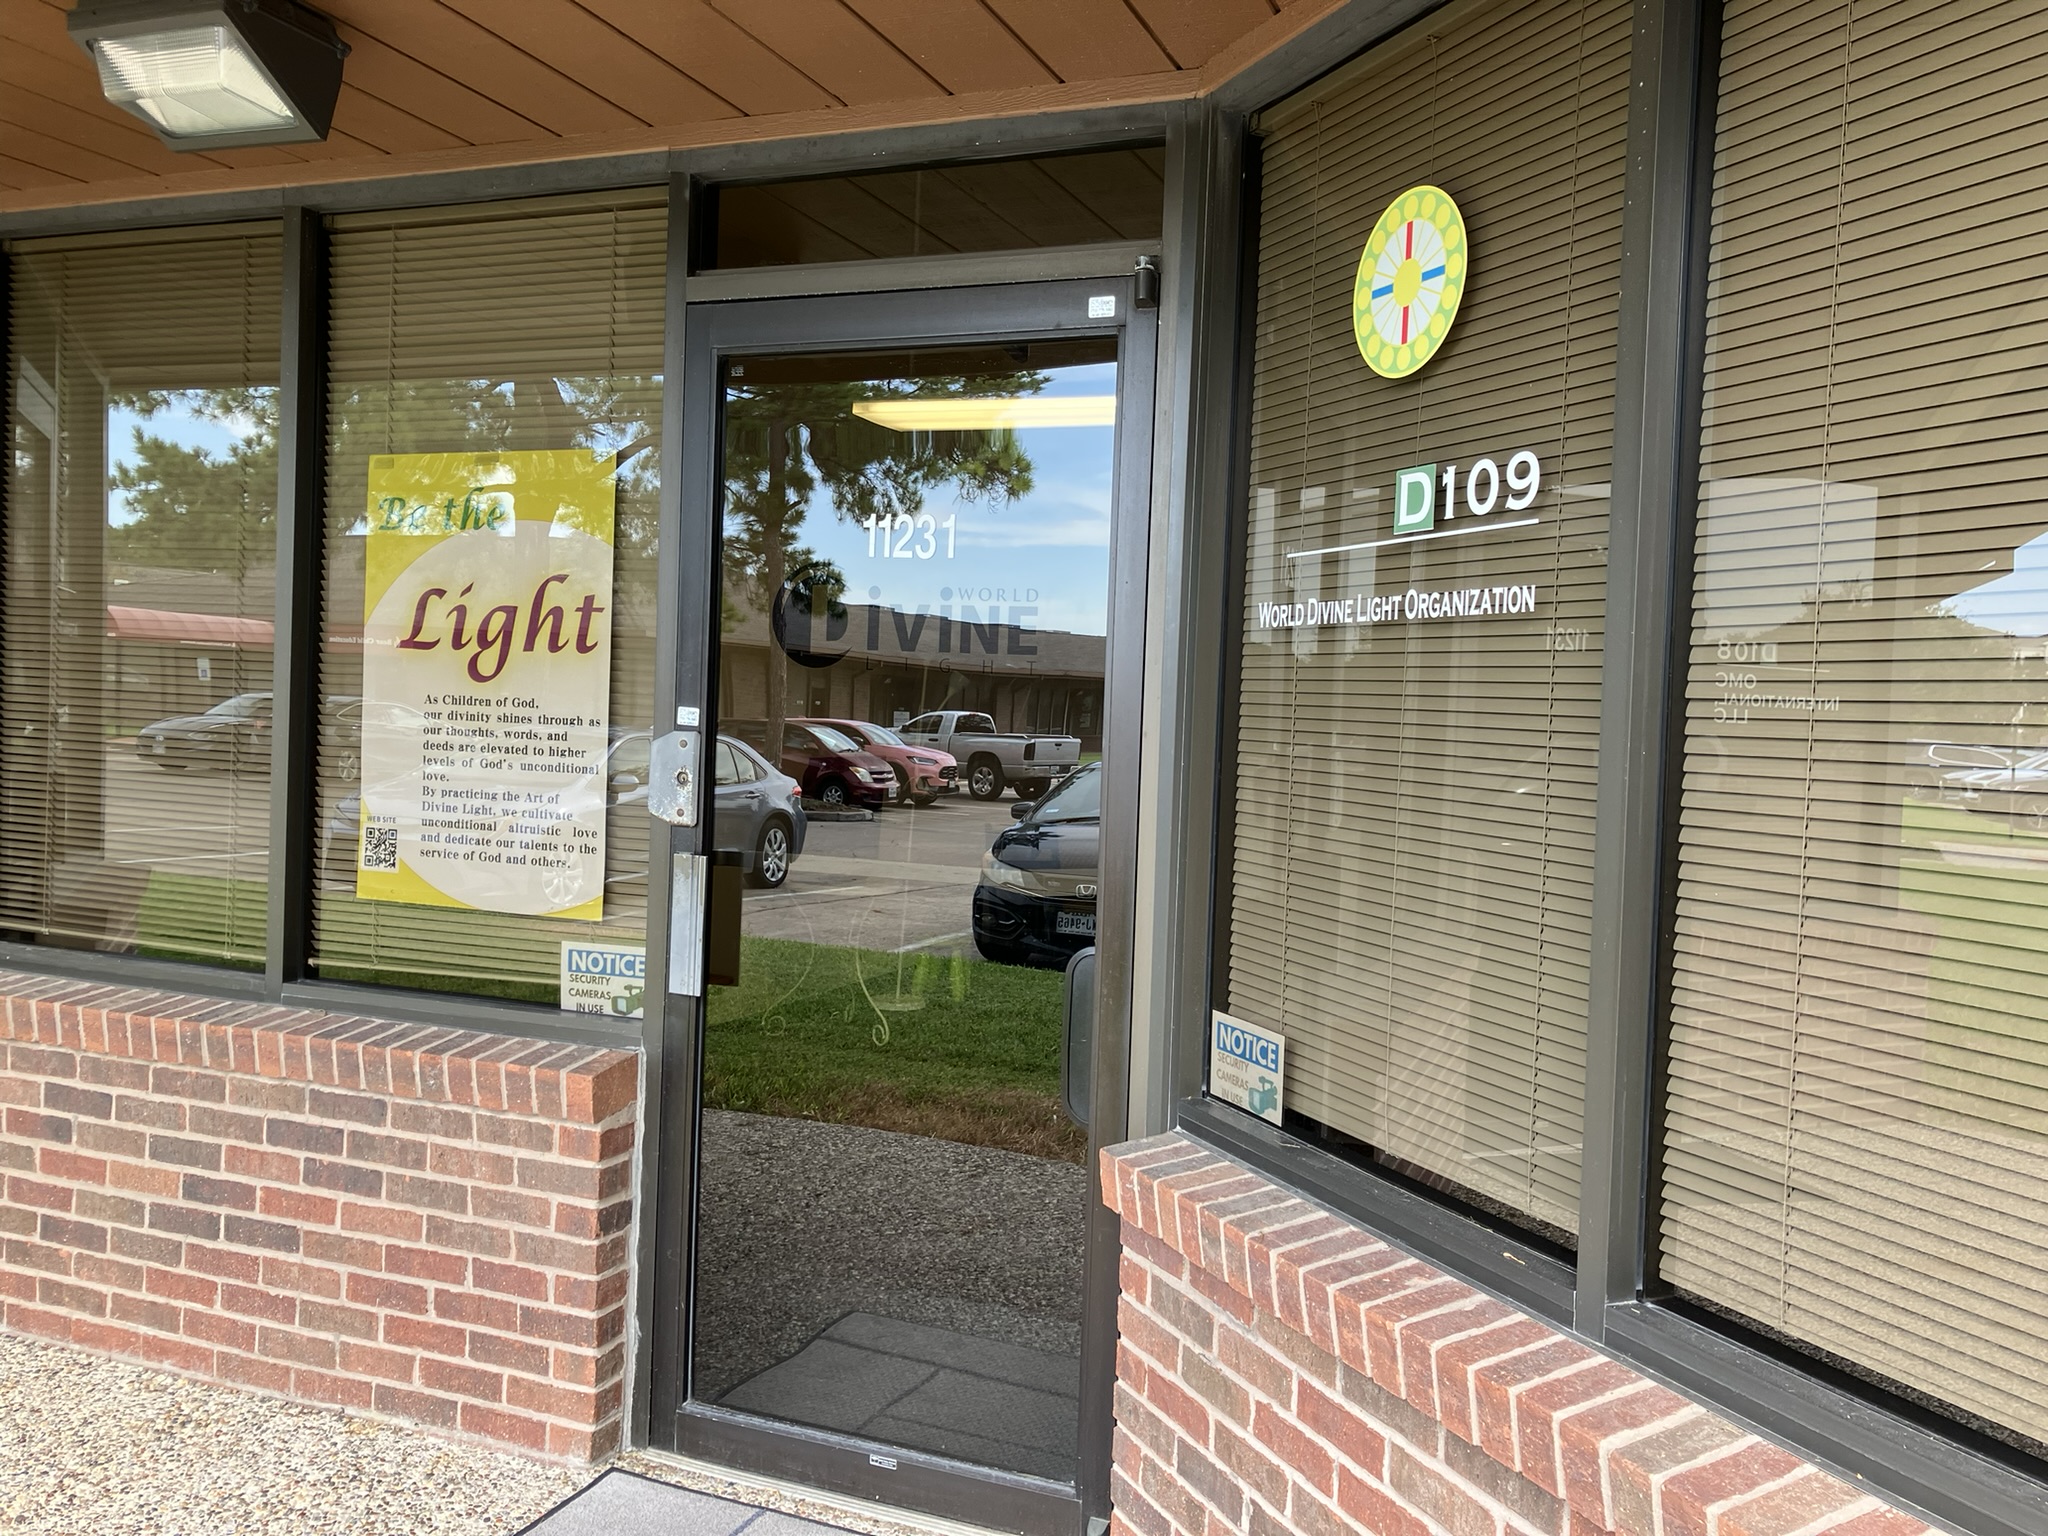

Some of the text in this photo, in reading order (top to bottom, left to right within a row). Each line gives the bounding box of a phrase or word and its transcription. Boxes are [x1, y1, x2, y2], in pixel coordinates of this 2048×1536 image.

[378, 486, 507, 531] Be the
[862, 513, 957, 560] 11231
[957, 587, 1039, 602] WORLD
[1258, 584, 1537, 629] WORLD DIVINE LIGHT ORGANIZATION
[396, 573, 606, 684] Light
[865, 658, 1037, 676] LIGHT
[424, 694, 439, 705] As
[442, 694, 492, 707] Children
[495, 697, 508, 708] of
[423, 710, 601, 727] our divinity shines through as
[423, 726, 442, 736] our
[546, 731, 568, 742] and
[422, 740, 587, 759] deeds are elevated to higher
[422, 755, 599, 776] levels of God's unconditional
[422, 770, 450, 782] love.
[422, 785, 560, 805] By practicing the Art of
[382, 816, 397, 824] SITE
[421, 800, 458, 814] Divine
[501, 808, 518, 818] we
[521, 808, 573, 822] cultivate
[421, 817, 598, 839] unconditional altruistic love
[420, 832, 597, 855] and dedicate our talents to the
[420, 848, 571, 869] service of God and others.
[571, 950, 645, 977] NOTICE
[569, 973, 611, 986] SECURITY
[568, 987, 612, 1001] CAMERAS
[576, 1002, 604, 1014] IN USE
[1219, 1023, 1277, 1071] NOTICE
[1217, 1051, 1250, 1073] SECURITY
[1216, 1068, 1249, 1092] CAMERAS
[1221, 1088, 1230, 1100] IN
